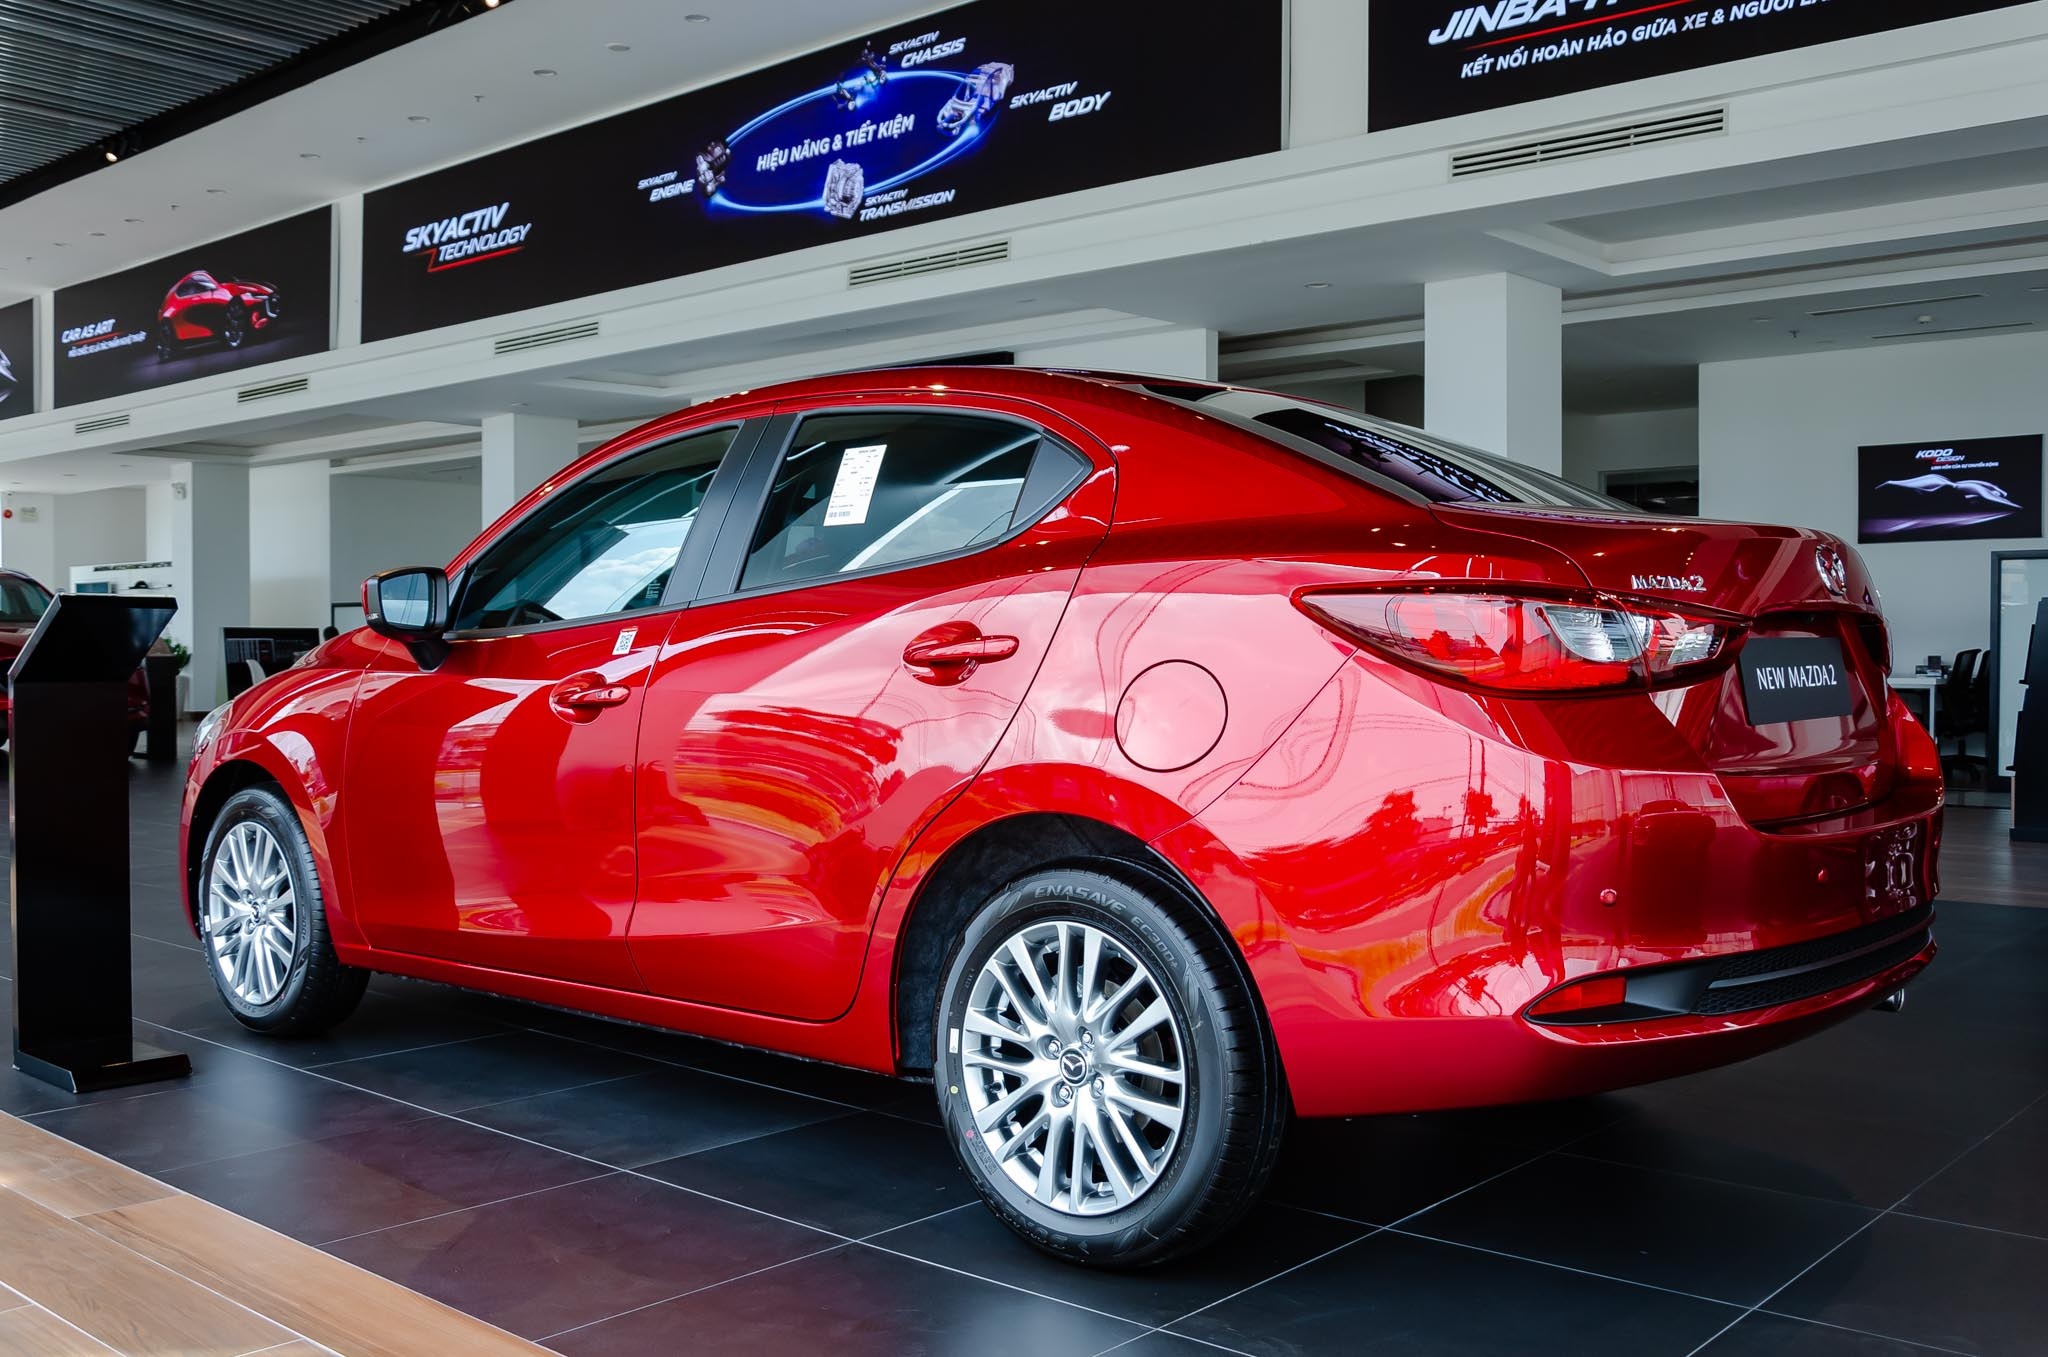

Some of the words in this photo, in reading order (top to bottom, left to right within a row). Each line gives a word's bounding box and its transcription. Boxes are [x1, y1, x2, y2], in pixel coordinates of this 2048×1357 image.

[888, 30, 940, 55] SKYACTIV
[900, 37, 966, 68] CHASSIS
[1461, 54, 1494, 78] KẾT
[1496, 46, 1528, 71] NỐI
[1531, 39, 1583, 63] HOÀN
[1587, 26, 1627, 52] HẢO
[1631, 18, 1677, 42] GIỮA
[1681, 12, 1708, 32] XE
[1711, 9, 1725, 25] &
[1009, 81, 1078, 109] SKYACTIV
[1048, 91, 1112, 122] BODY
[756, 147, 789, 172] HIỆU
[789, 138, 830, 161] NĂNG
[831, 133, 843, 151] &
[877, 113, 915, 139] KIỆM
[637, 171, 678, 190] SKYACTIV
[649, 178, 696, 202] ENGINE
[860, 189, 956, 222] TRANSMISSION
[864, 188, 909, 207] SKYACTIV
[402, 202, 510, 252] SKYACTIV
[438, 222, 532, 262] TECHNOLOGY
[61, 327, 82, 344] CAR
[94, 318, 116, 336] ART
[1915, 448, 1953, 459] KODO
[1756, 666, 1785, 690] NEW
[1787, 664, 1837, 688] MAZDA2
[1034, 884, 1127, 915] ENASAVE
